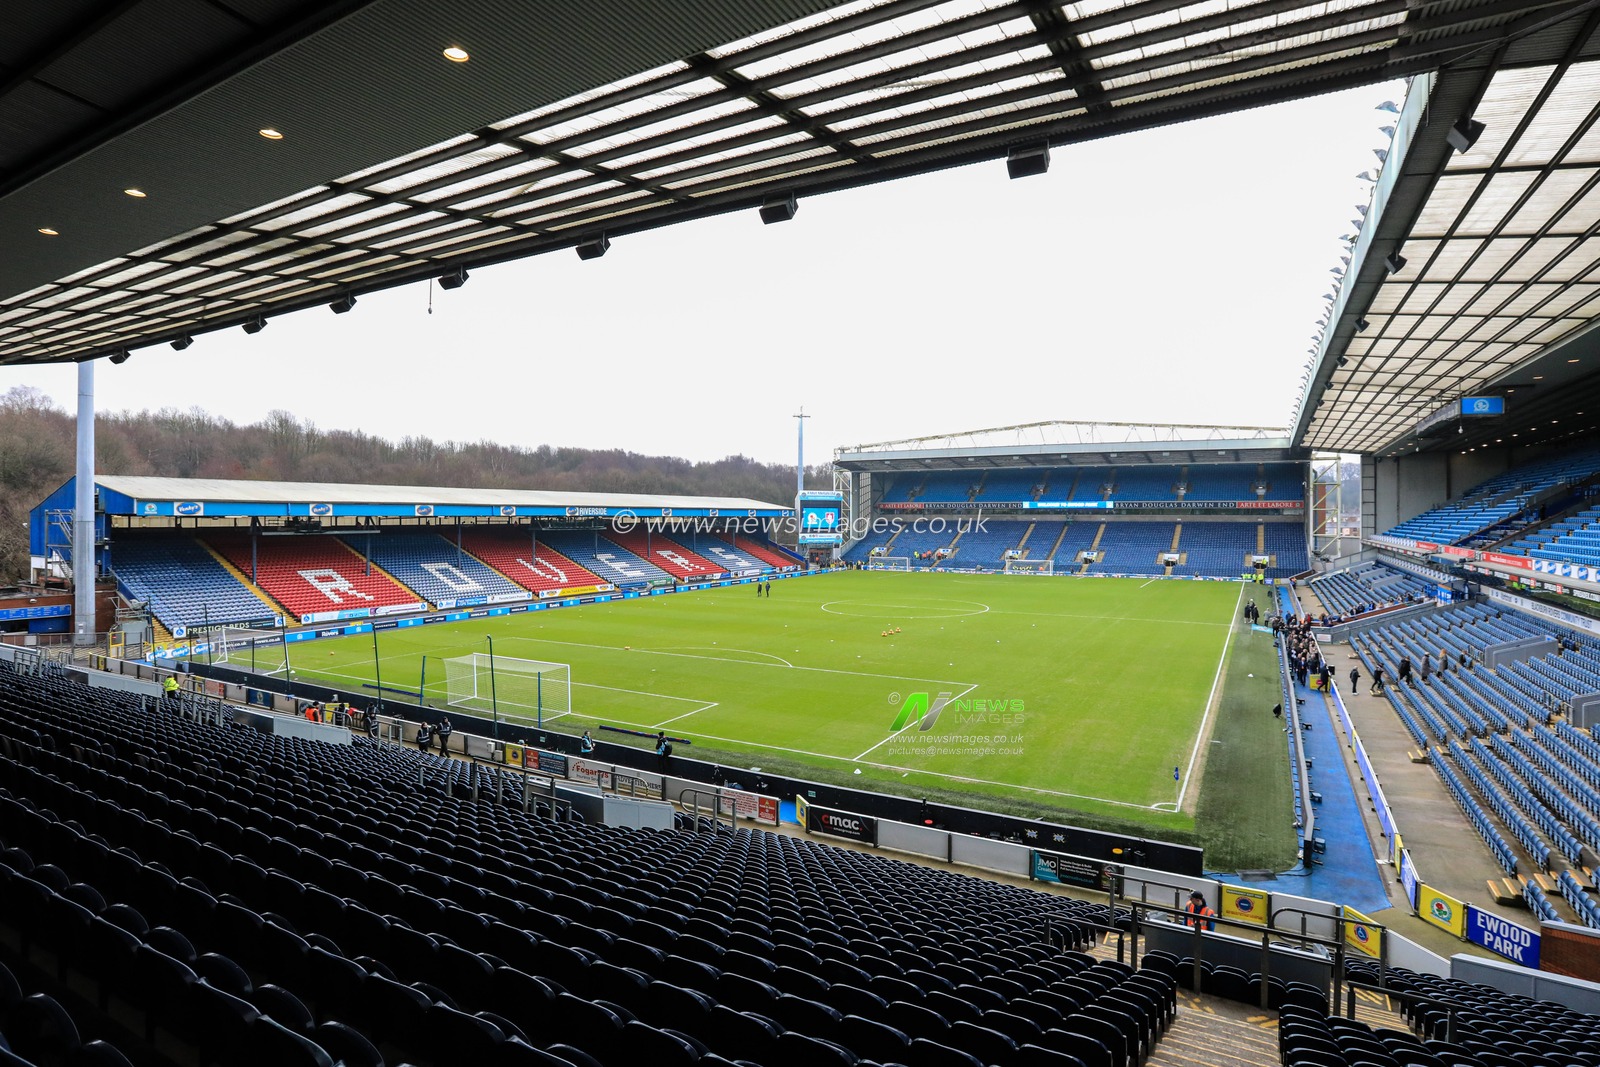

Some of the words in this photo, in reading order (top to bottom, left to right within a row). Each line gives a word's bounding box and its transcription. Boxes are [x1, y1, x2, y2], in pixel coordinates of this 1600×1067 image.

[579, 507, 608, 516] RIVERSIDE
[187, 624, 225, 634] PRESTIGE
[230, 622, 250, 630] BEDS
[1038, 858, 1056, 868] JMO
[1038, 866, 1056, 874] Creative
[1477, 912, 1531, 948] EWOOD
[1484, 930, 1524, 962] PARK
